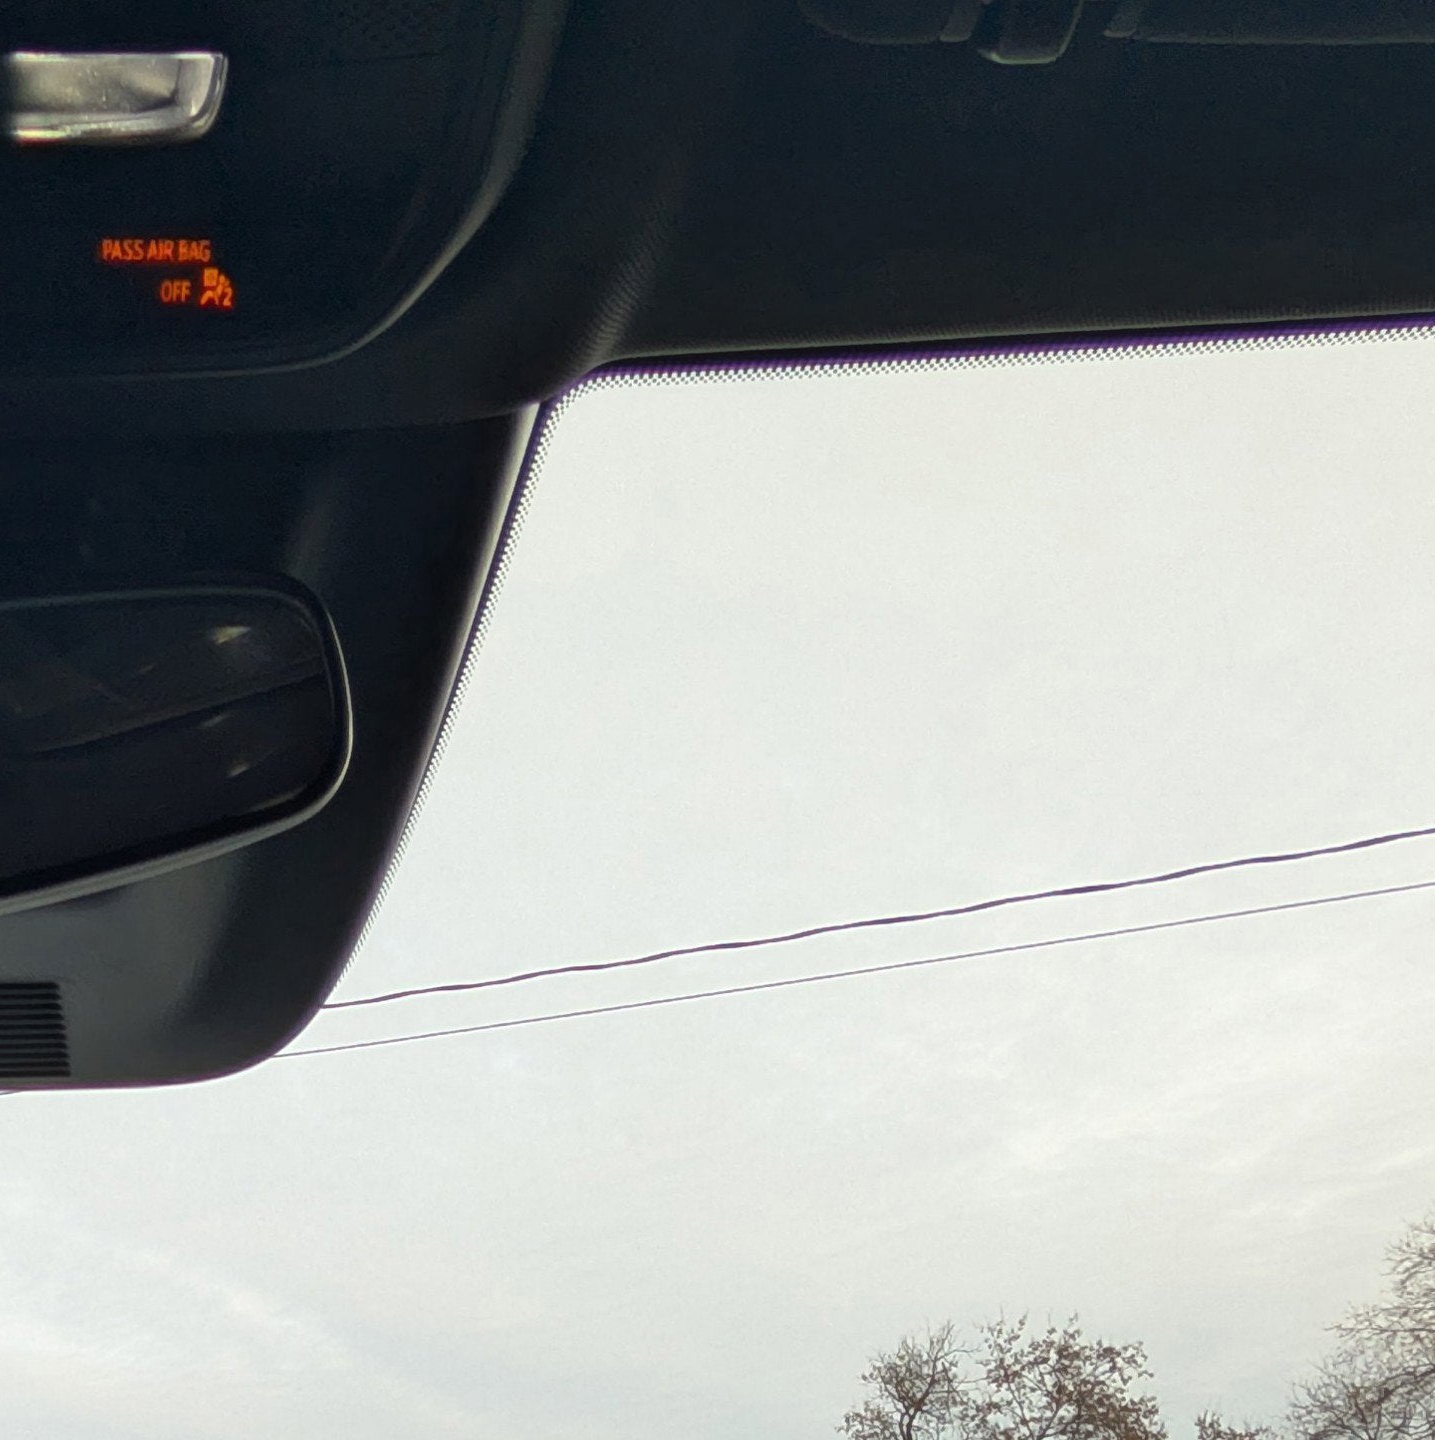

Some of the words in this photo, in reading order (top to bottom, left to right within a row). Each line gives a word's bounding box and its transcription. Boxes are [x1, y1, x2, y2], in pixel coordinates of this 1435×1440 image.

[101, 238, 144, 261] PASS
[147, 238, 174, 261] AIR
[178, 238, 211, 262] BAG
[160, 280, 191, 302] OFF
